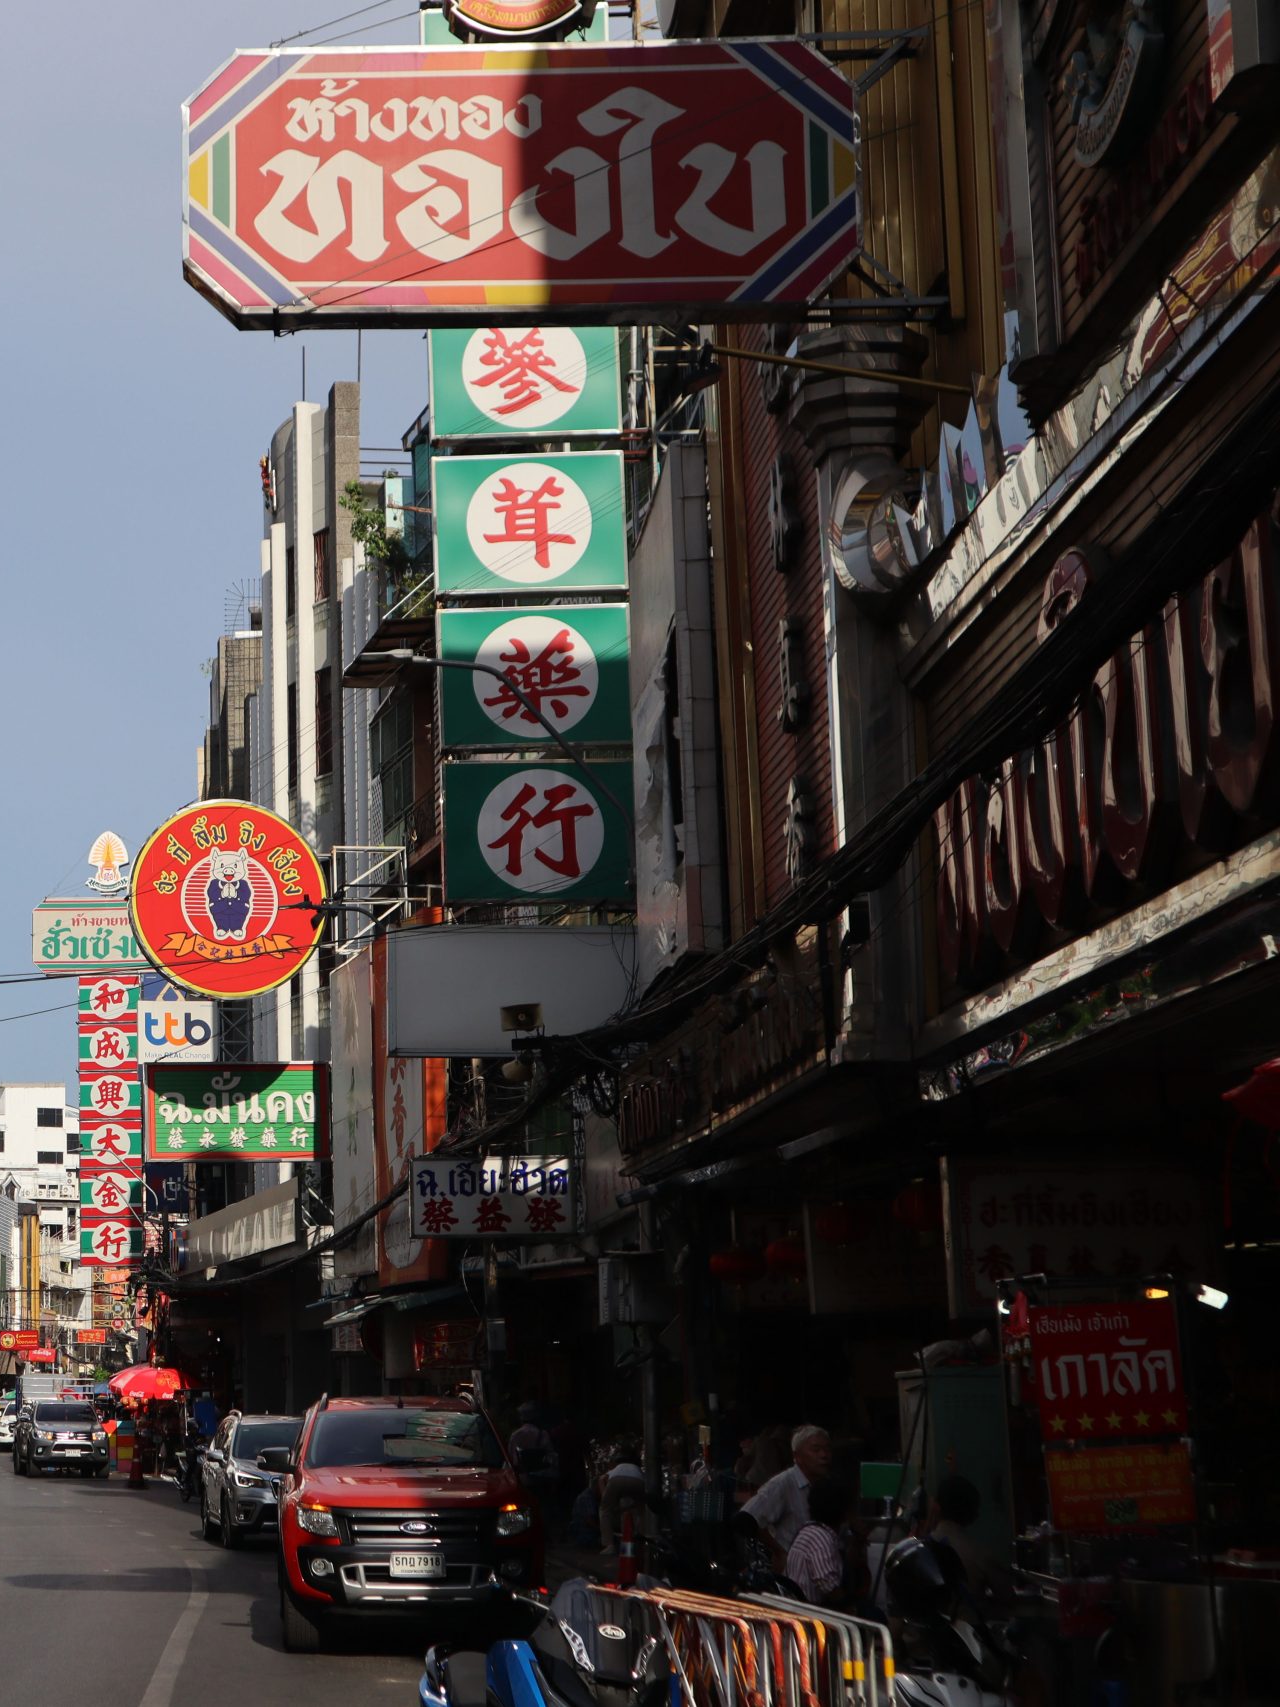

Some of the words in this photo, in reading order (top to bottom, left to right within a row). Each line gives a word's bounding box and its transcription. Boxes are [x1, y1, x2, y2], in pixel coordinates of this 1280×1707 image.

[286, 78, 543, 143] ห้างทอง
[145, 1012, 212, 1046] ttb
[185, 1052, 211, 1060] Change
[158, 1071, 317, 1124] ฉ.มั่นคง
[420, 1197, 567, 1233] 蔡益發
[417, 1556, 440, 1567] 7918
